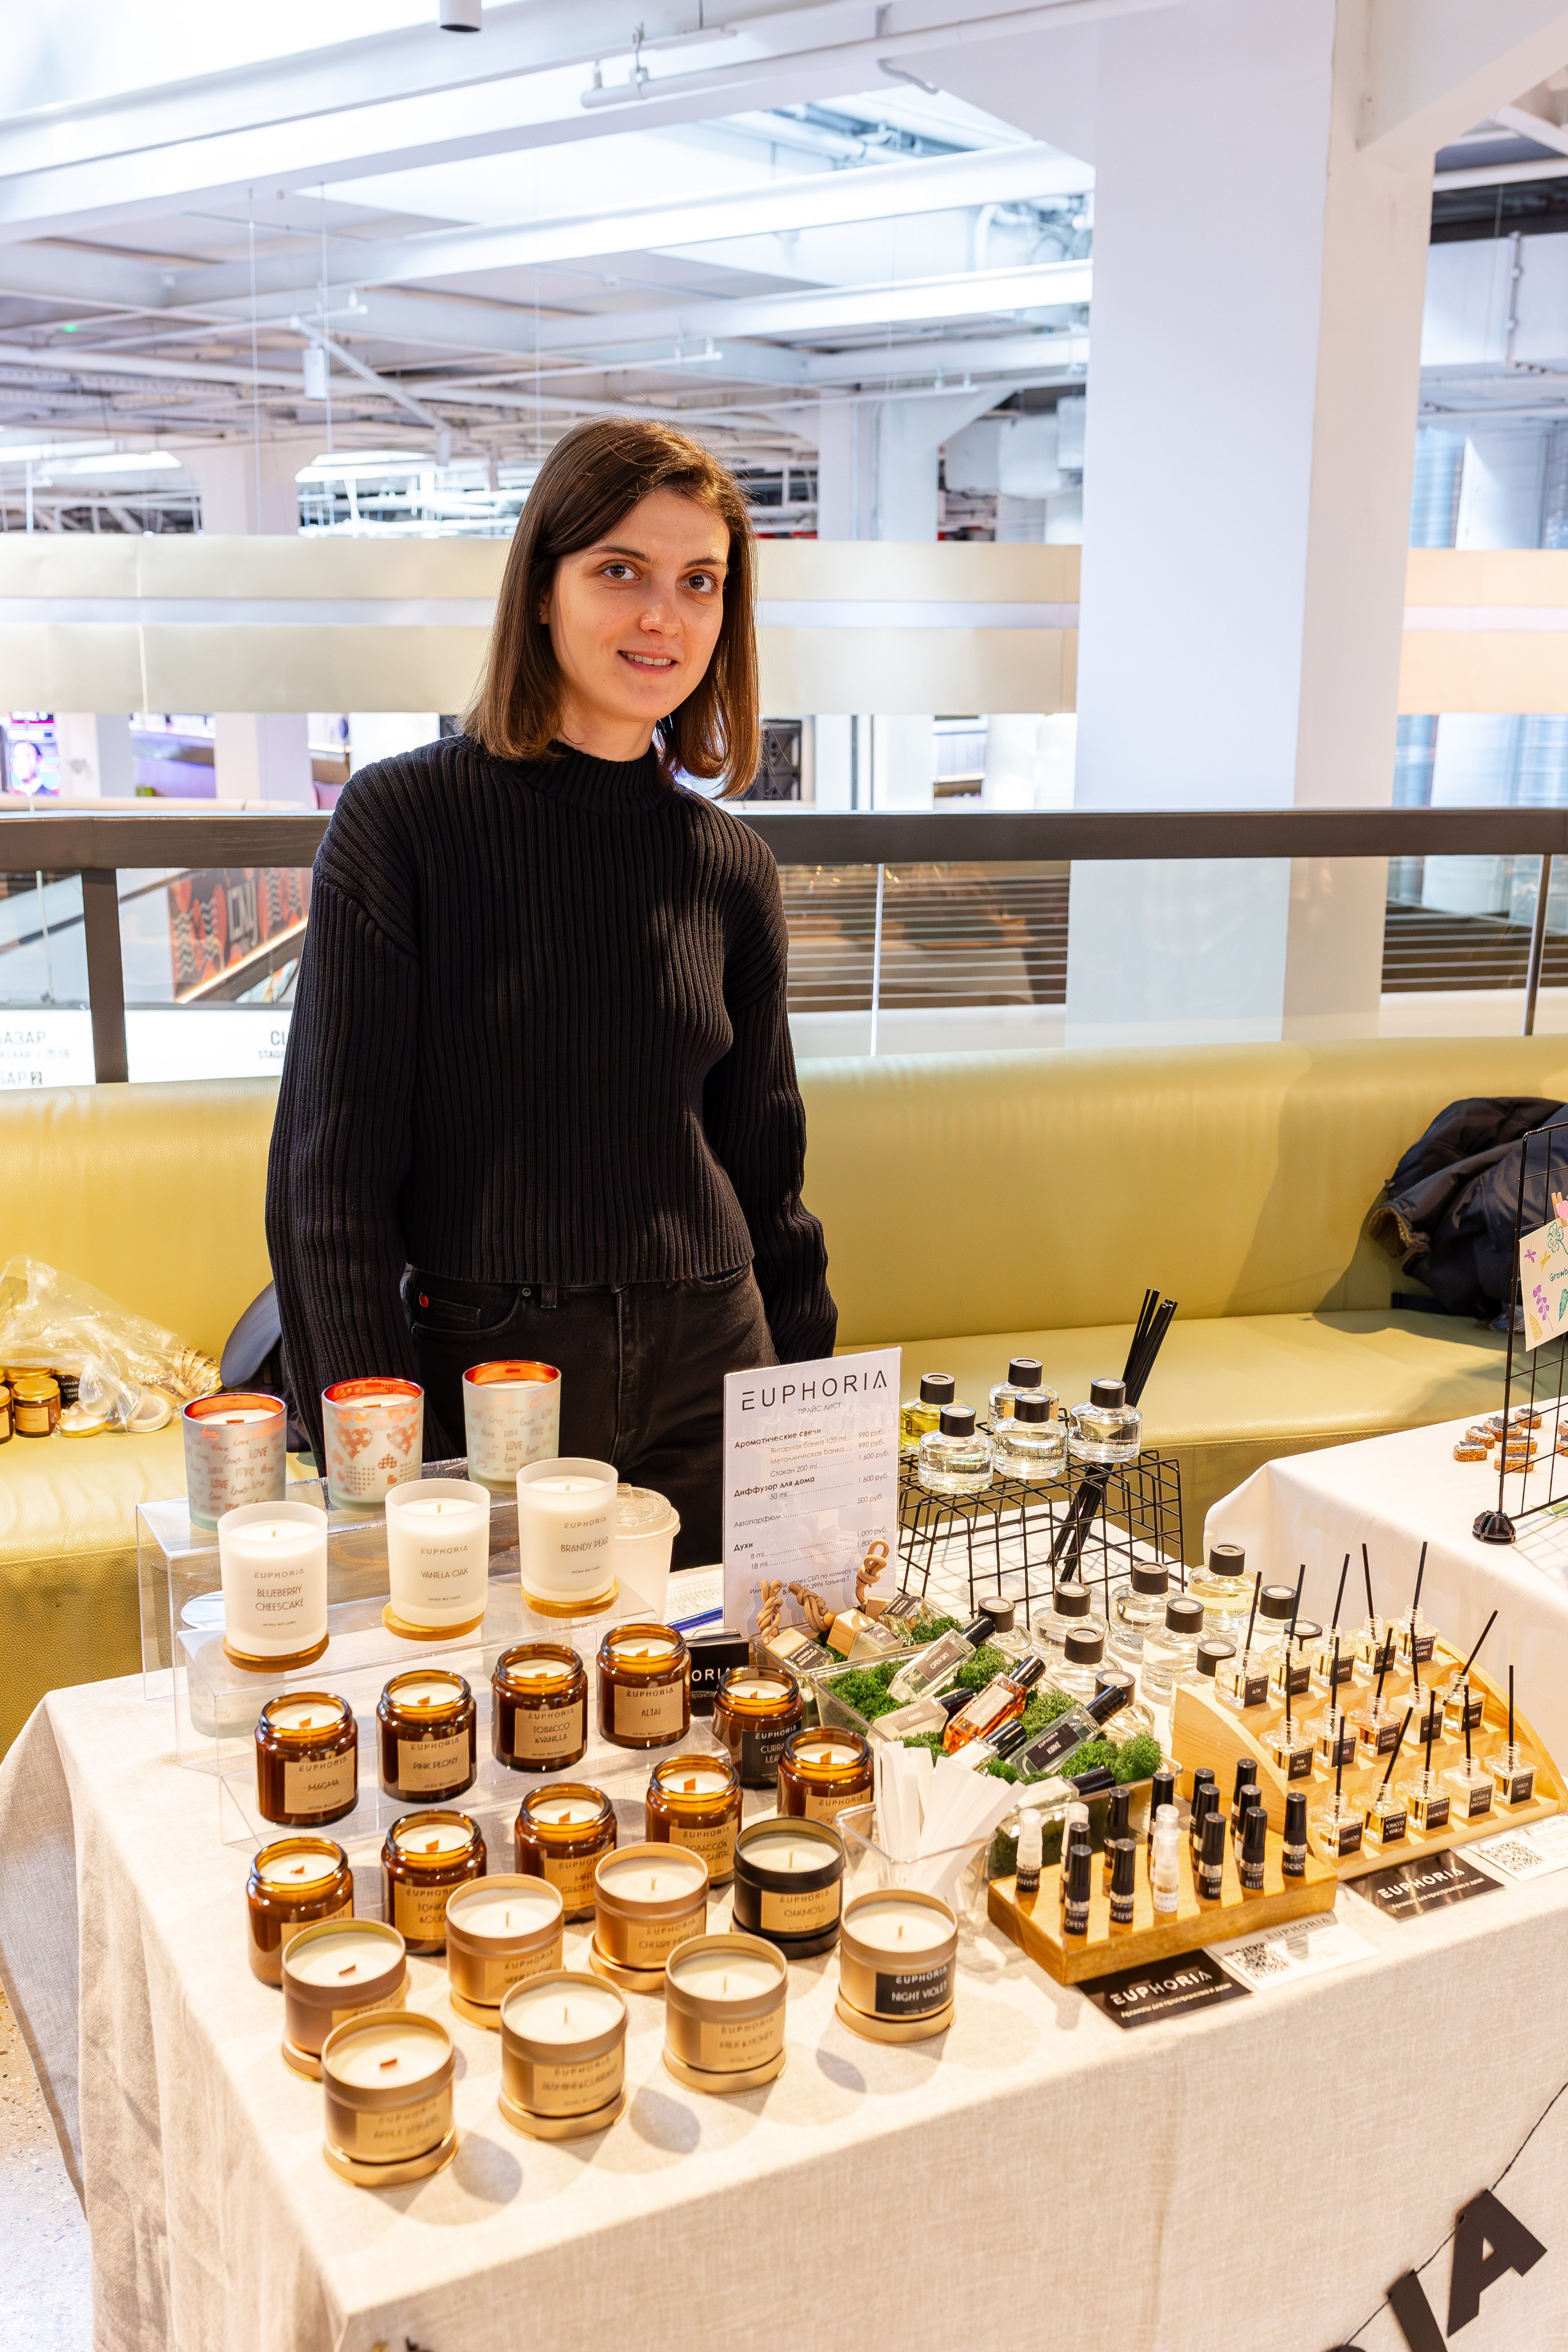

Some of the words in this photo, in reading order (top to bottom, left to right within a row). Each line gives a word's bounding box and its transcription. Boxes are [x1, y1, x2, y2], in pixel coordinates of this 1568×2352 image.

[742, 1370, 888, 1411] EUPHORIA
[797, 1404, 822, 1415] ПРАЙС
[823, 1401, 842, 1411] ЛИСТ
[734, 1432, 797, 1449] Ароматические
[799, 1428, 821, 1437] свечи
[870, 1439, 885, 1449] руб.
[770, 1444, 802, 1455] Янтарная
[803, 1439, 824, 1449] банка
[770, 1450, 822, 1465] Металлическая
[859, 1452, 875, 1461] 1.600
[875, 1450, 890, 1460] руб.
[770, 1468, 795, 1477] Стакан
[858, 1475, 874, 1483] 1.600
[875, 1472, 889, 1482] руб.
[734, 1484, 778, 1498] Диффузор
[779, 1480, 793, 1489] для
[794, 1476, 815, 1487] дома
[858, 1496, 869, 1504] 500
[869, 1493, 884, 1503] руб.
[564, 1515, 607, 1529] EUPHORIA
[857, 1528, 873, 1538] 1.000
[873, 1526, 888, 1536] руб.
[420, 1545, 469, 1555] EUPHORIA
[560, 1542, 593, 1553] BRANDY
[594, 1536, 609, 1549] PEAR
[734, 1542, 753, 1552] Духи
[254, 1567, 305, 1579] EUPHORIA
[421, 1570, 450, 1579] VANILLA
[451, 1567, 469, 1577] OAK
[257, 1585, 303, 1598] BLUEBERRY
[255, 1598, 304, 1611] CHEESCAKE
[627, 1687, 674, 1698] EUPHORIA
[528, 1708, 575, 1720] EUPHORIA
[533, 1722, 570, 1734] TOBACCO
[755, 1725, 797, 1740] EUPHORIA
[410, 1738, 459, 1751] EUPHORIA
[760, 1743, 785, 1754] CURRA
[299, 1756, 347, 1773] EUPHORIA
[765, 1754, 780, 1764] LEA
[818, 1795, 864, 1806] EUPHORIA
[683, 1826, 730, 1838] EUPHORIA
[559, 1852, 600, 1869] EUPHOR
[1377, 1867, 1466, 1899] EUPHORIA
[406, 1888, 453, 1897] EUPHOR
[780, 1890, 830, 1904] EUPHORIA
[1265, 1917, 1331, 1940] EUPHORIA
[895, 1964, 948, 1985] EUPHORIA
[1109, 1970, 1213, 2006] EUPHORIA
[720, 2016, 774, 2035] EUPHORIA
